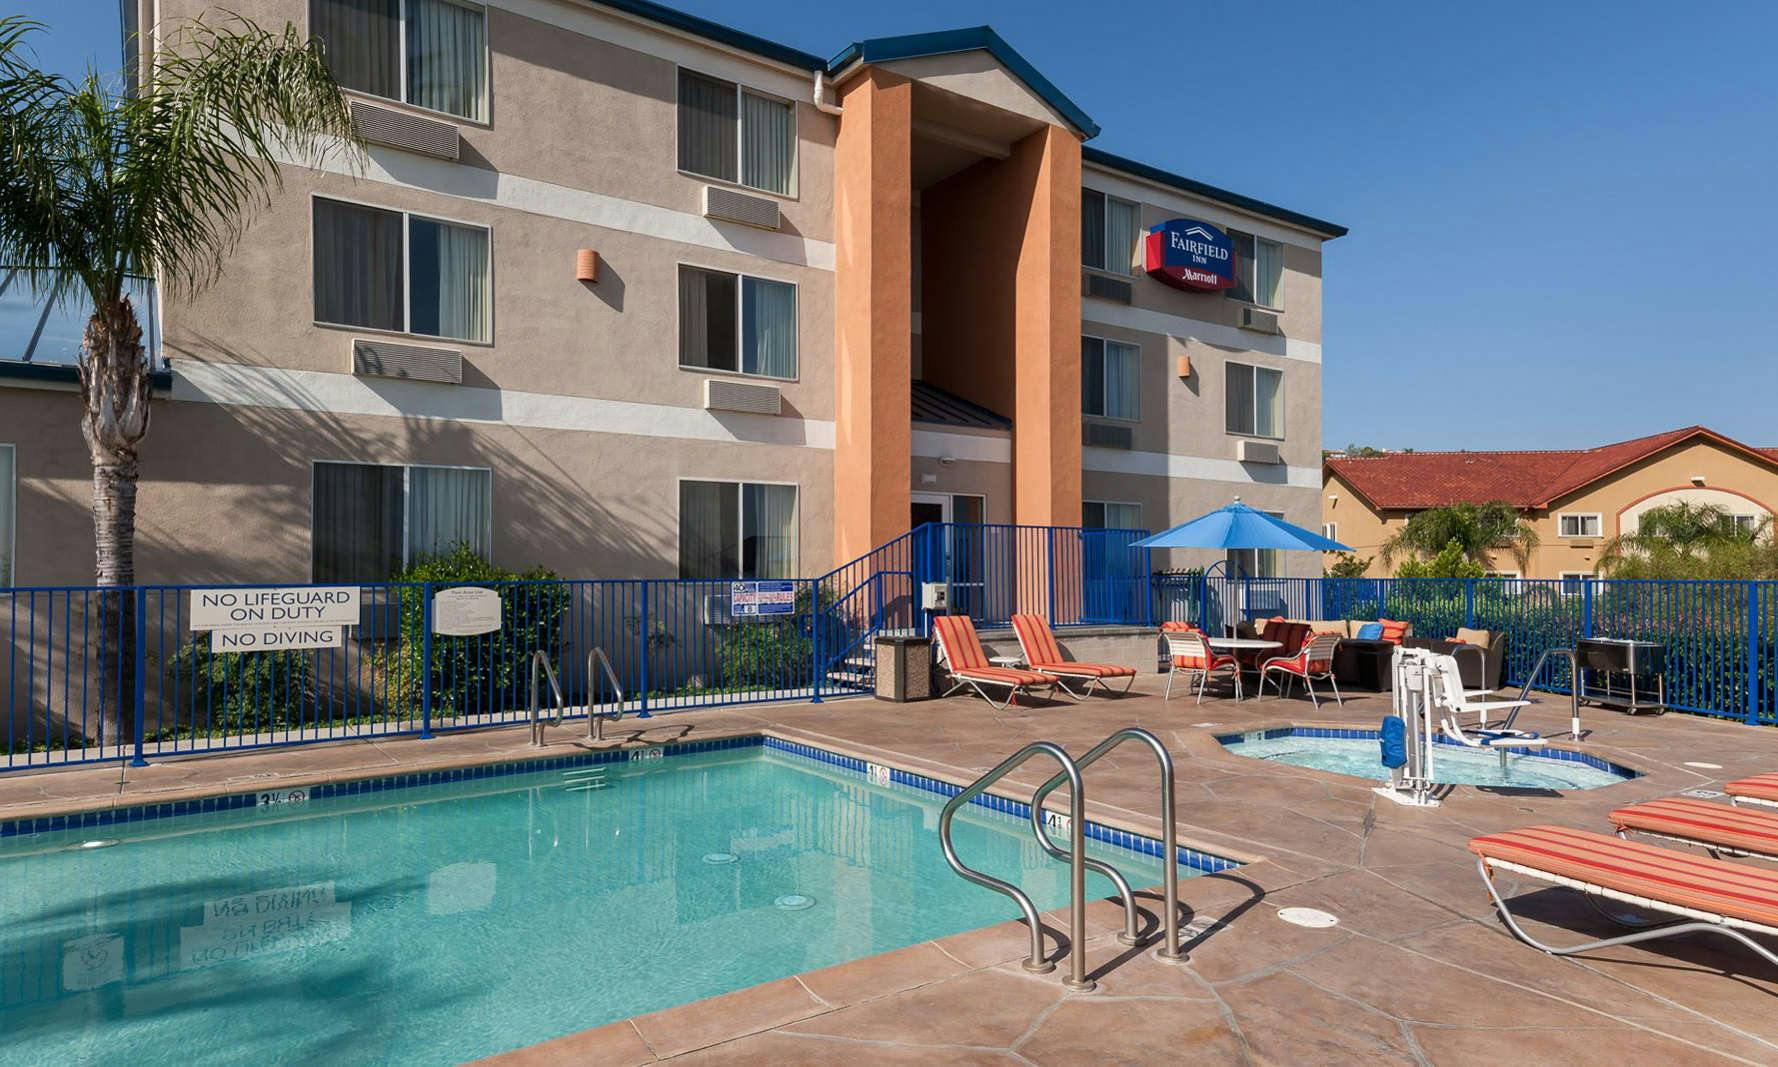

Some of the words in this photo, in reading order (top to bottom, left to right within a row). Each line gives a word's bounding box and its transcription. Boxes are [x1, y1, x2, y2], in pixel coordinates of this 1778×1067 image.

[1170, 231, 1228, 260] FAIRFIELD
[1192, 254, 1208, 265] INN
[1182, 268, 1217, 285] Marriott
[202, 593, 238, 607] NO
[244, 591, 350, 606] LIFEGUARD
[230, 608, 264, 621] ON
[271, 606, 325, 620] DUTY
[222, 633, 256, 647] NO
[263, 630, 334, 645] DIVING
